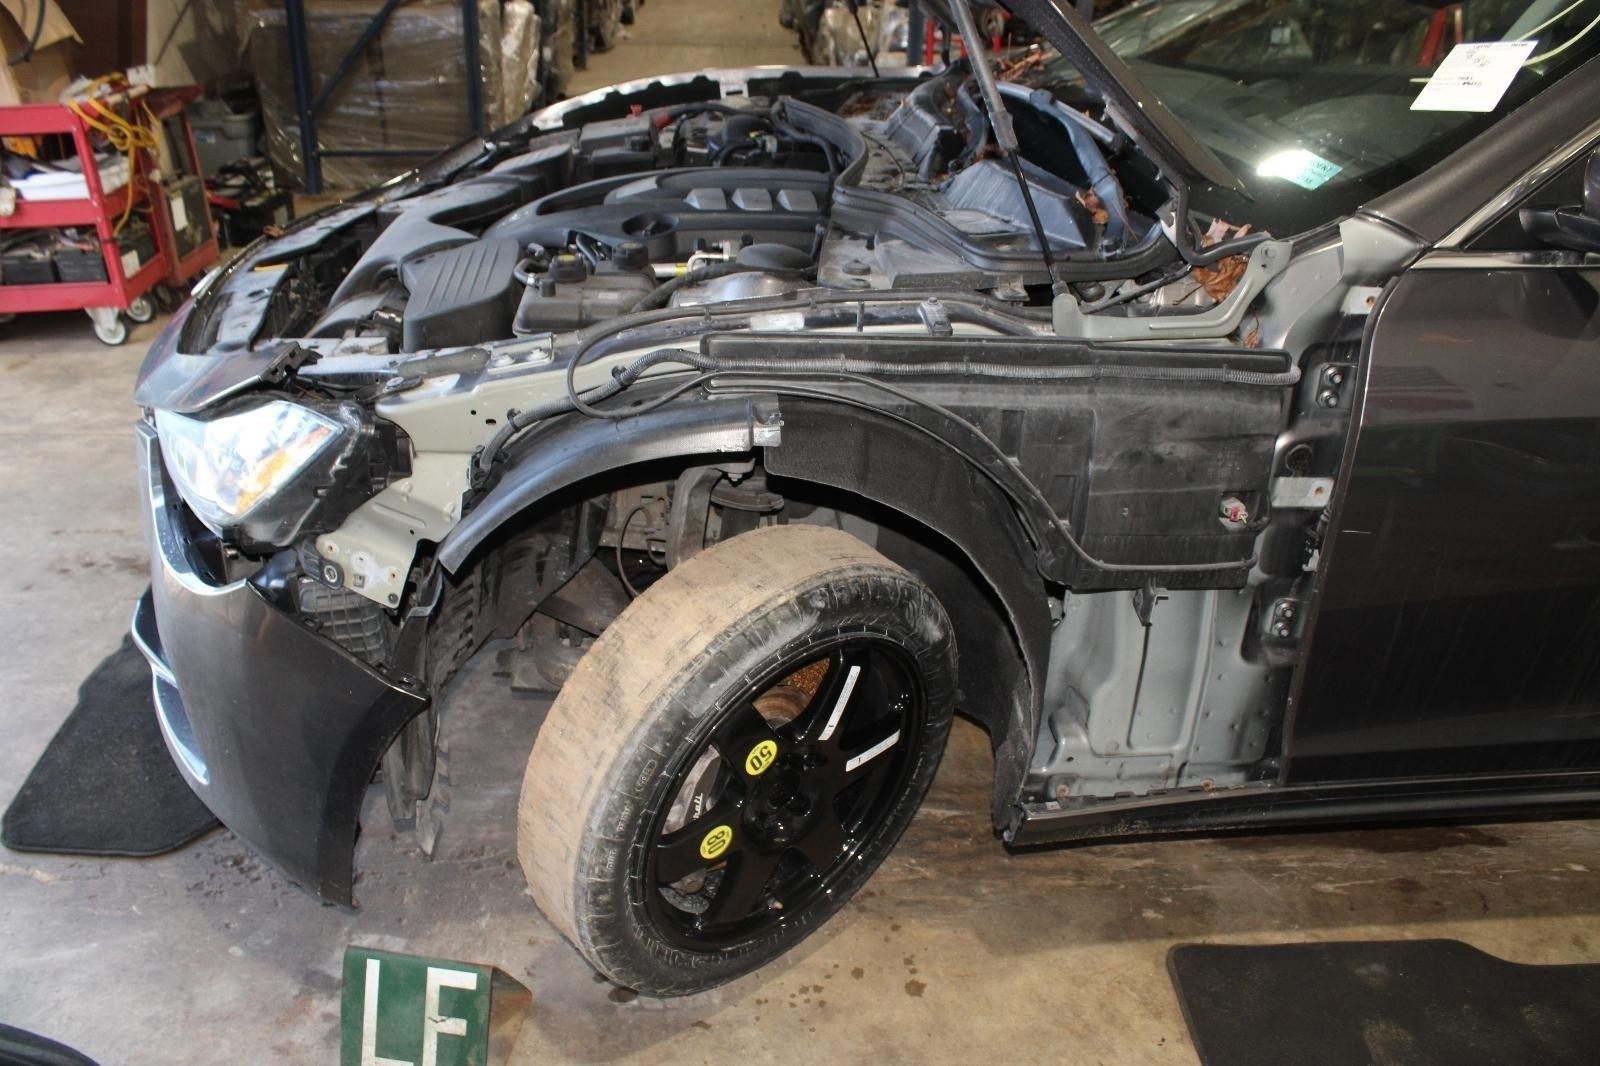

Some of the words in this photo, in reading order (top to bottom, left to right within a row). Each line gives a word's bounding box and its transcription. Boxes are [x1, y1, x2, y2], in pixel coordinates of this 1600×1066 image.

[750, 745, 773, 771] 50
[706, 830, 727, 855] 80
[361, 958, 478, 1066] LF
